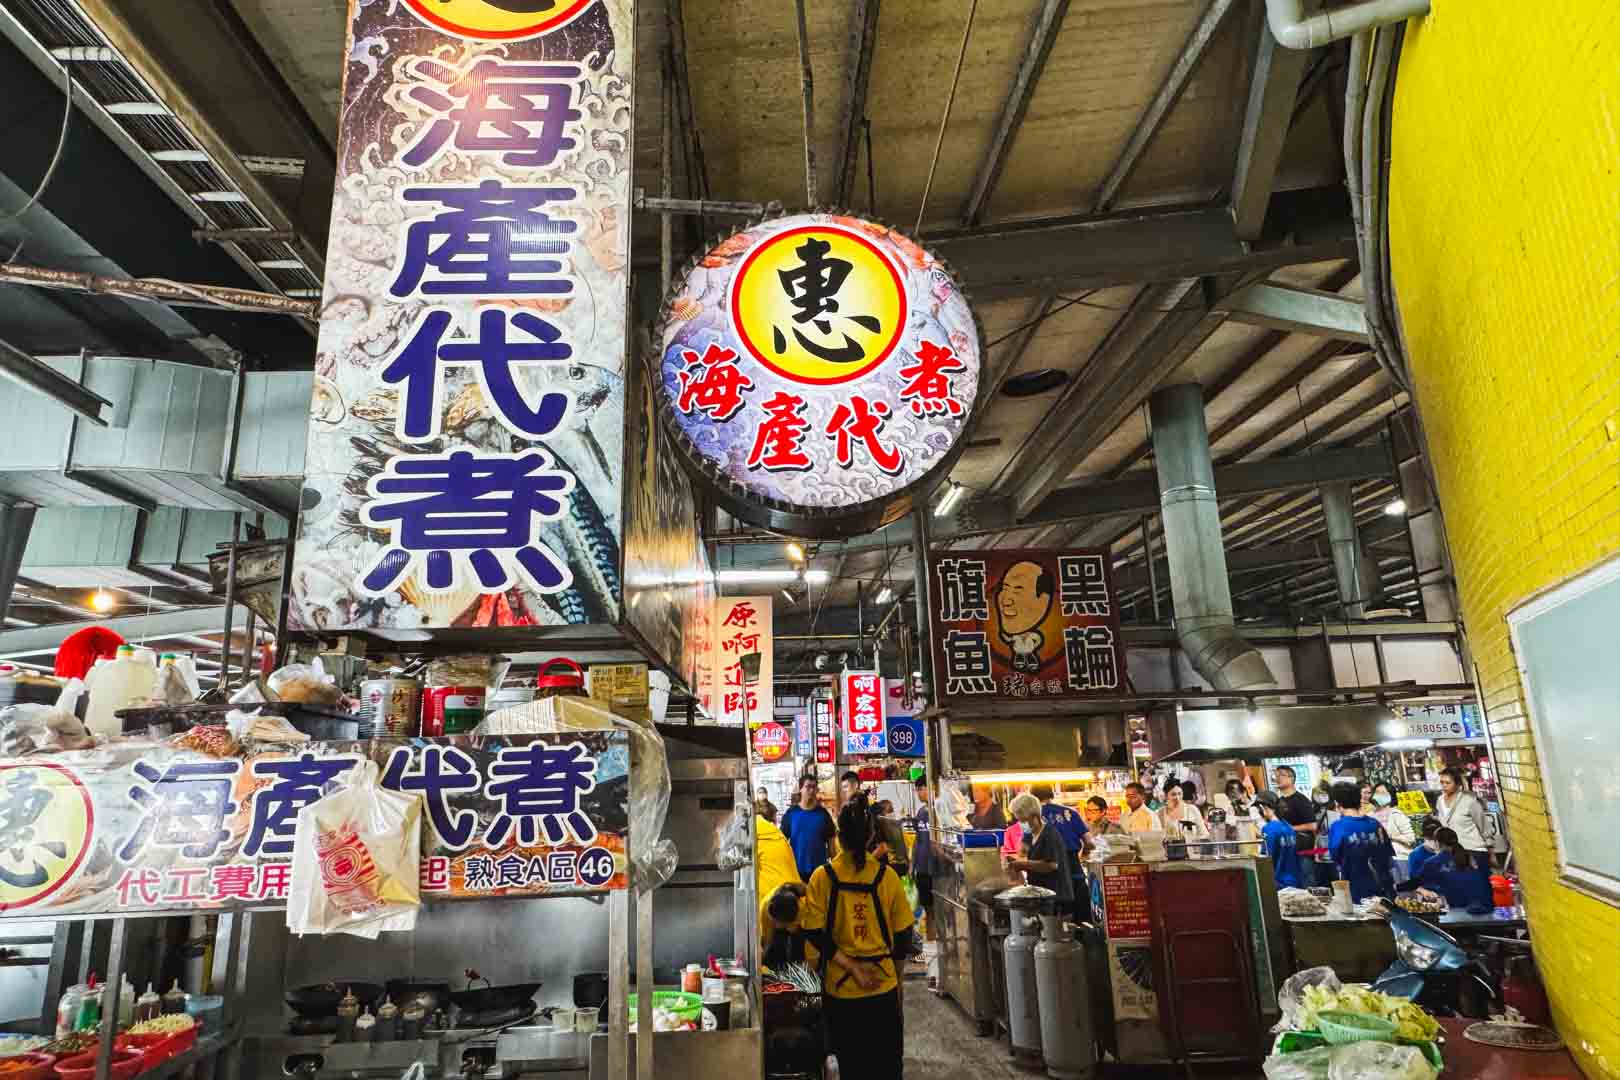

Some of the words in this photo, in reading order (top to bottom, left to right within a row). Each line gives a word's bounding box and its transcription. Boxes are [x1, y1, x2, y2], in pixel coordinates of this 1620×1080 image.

[359, 57, 584, 595] 海產代煮
[772, 237, 882, 363] 惠
[676, 340, 964, 473] 海產代煮
[937, 559, 998, 695] 旗魚
[1057, 555, 1119, 690] 黑輪
[853, 676, 878, 732] 啊宏師
[892, 731, 913, 744] 398
[465, 854, 577, 888] 熟食A區
[580, 856, 612, 879] 46
